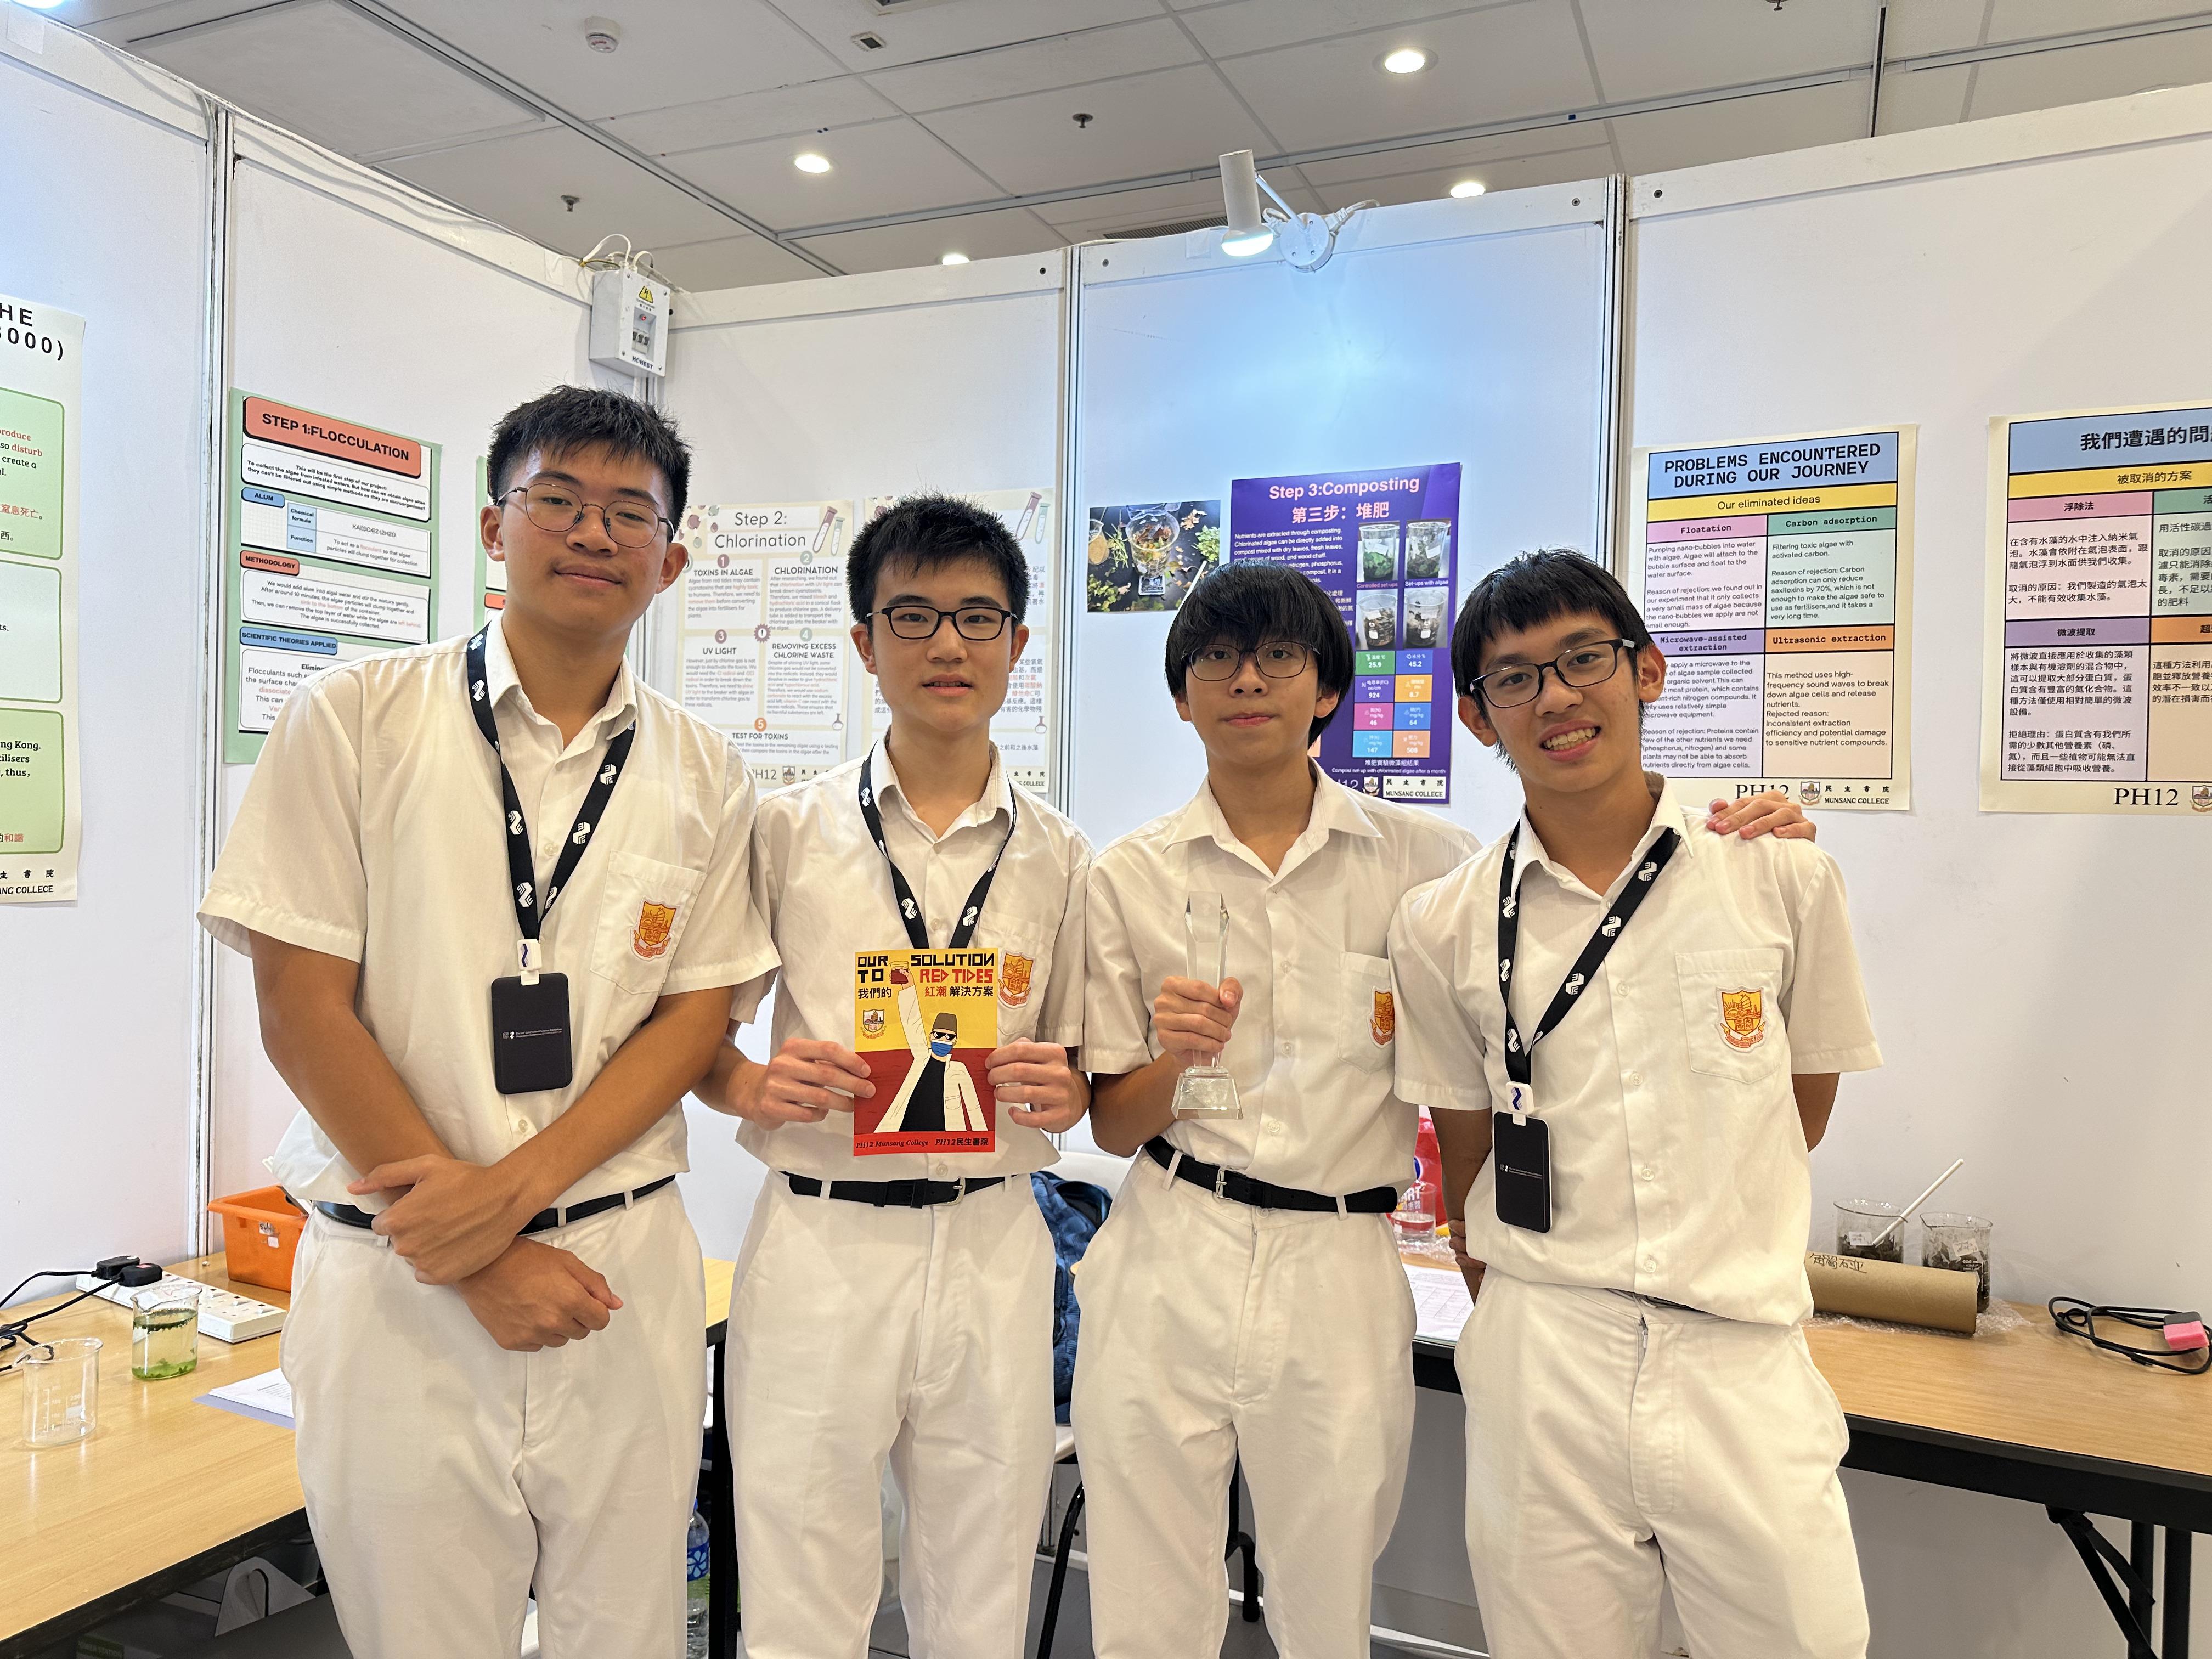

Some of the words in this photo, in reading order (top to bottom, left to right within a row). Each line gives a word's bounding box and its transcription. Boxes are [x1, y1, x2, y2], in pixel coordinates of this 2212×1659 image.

[262, 413, 298, 430] STEP
[302, 424, 410, 461] 1:FLOCCULATION
[11, 444, 43, 457] disturb
[2, 455, 29, 466] create
[1665, 454, 1747, 472] PROBLEMS
[1759, 443, 1880, 464] ENCOUNTERED
[1674, 471, 1736, 487] DURING
[1747, 467, 1779, 481] OUR
[1791, 460, 1868, 478] JOURNEY
[2116, 470, 2192, 482] 被取消的方案
[1268, 486, 1304, 501] Step
[1308, 477, 1420, 496] 3:Composting
[1717, 501, 1735, 509] Our
[1738, 496, 1790, 508] eliminated
[1793, 496, 1820, 504] ideas
[2063, 501, 2095, 511] 浮除法
[1290, 501, 1390, 523] 第三步：堆肥
[735, 512, 768, 528] Step
[774, 511, 786, 524] 2:
[1823, 516, 1877, 524] adsorption
[1310, 527, 1343, 536] composting.
[1681, 525, 1731, 533] Floatation
[290, 535, 313, 543] Function
[715, 534, 805, 548] Chlorination
[245, 556, 295, 568] METHODOLOGY
[720, 557, 725, 567] 1
[803, 554, 809, 563] 2
[2156, 597, 2190, 607] 的肥料
[718, 631, 724, 640] 3
[803, 630, 808, 639] 4
[2056, 627, 2096, 637] 微波提取
[242, 633, 277, 641] SCIENTIFIC
[279, 637, 309, 645] THEORIES
[1660, 634, 1746, 642] Microwave-assisted
[1831, 634, 1886, 642] extraction
[248, 667, 285, 676] Flocculants
[2008, 708, 2030, 716] 設備。
[15, 741, 41, 751] Kong.
[5, 768, 30, 777] thus,
[2114, 788, 2178, 805] PH12
[15, 885, 54, 894] COLLEGE
[858, 955, 888, 967] OUR
[911, 953, 994, 966] SOLUTION
[858, 968, 884, 983] TO
[919, 968, 949, 983] RED
[952, 968, 993, 983] TIDES
[858, 987, 892, 999] 我們的
[924, 986, 947, 997] 紅潮
[949, 986, 994, 997] 解決方案
